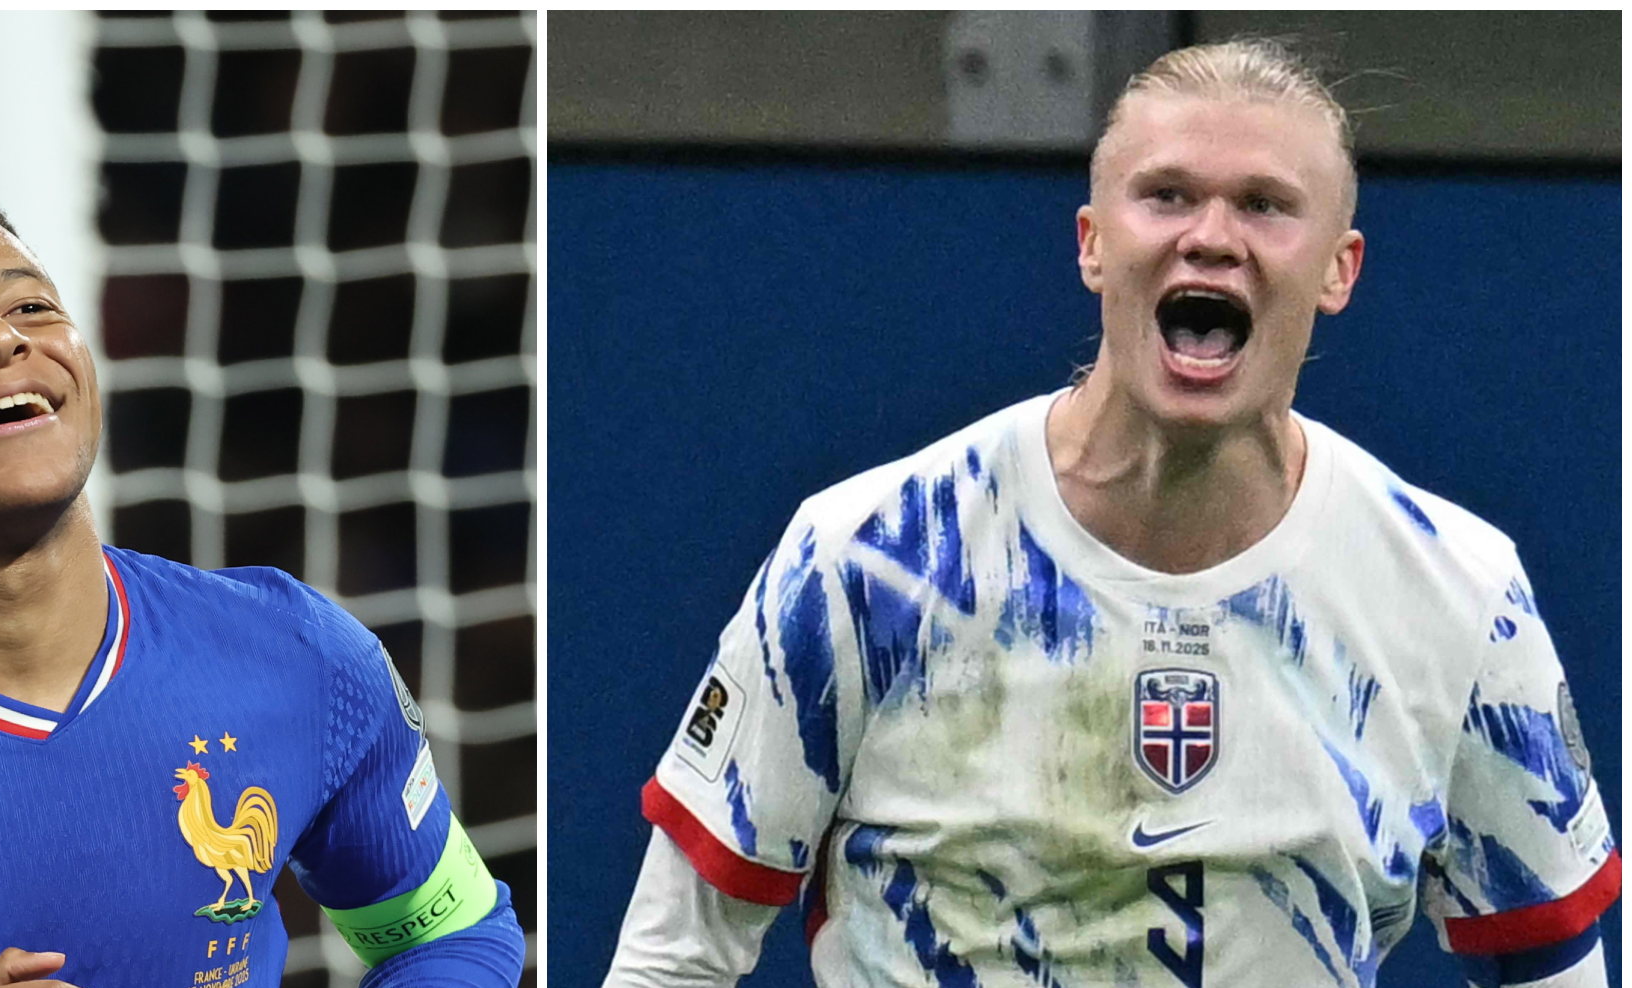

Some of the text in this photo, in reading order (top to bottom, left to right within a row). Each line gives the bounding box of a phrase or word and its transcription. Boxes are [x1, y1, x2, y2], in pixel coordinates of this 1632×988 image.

[1144, 621, 1166, 634] ITA
[1179, 624, 1210, 637] NOR
[354, 883, 456, 945] RESPECT
[194, 966, 223, 985] FRANCE
